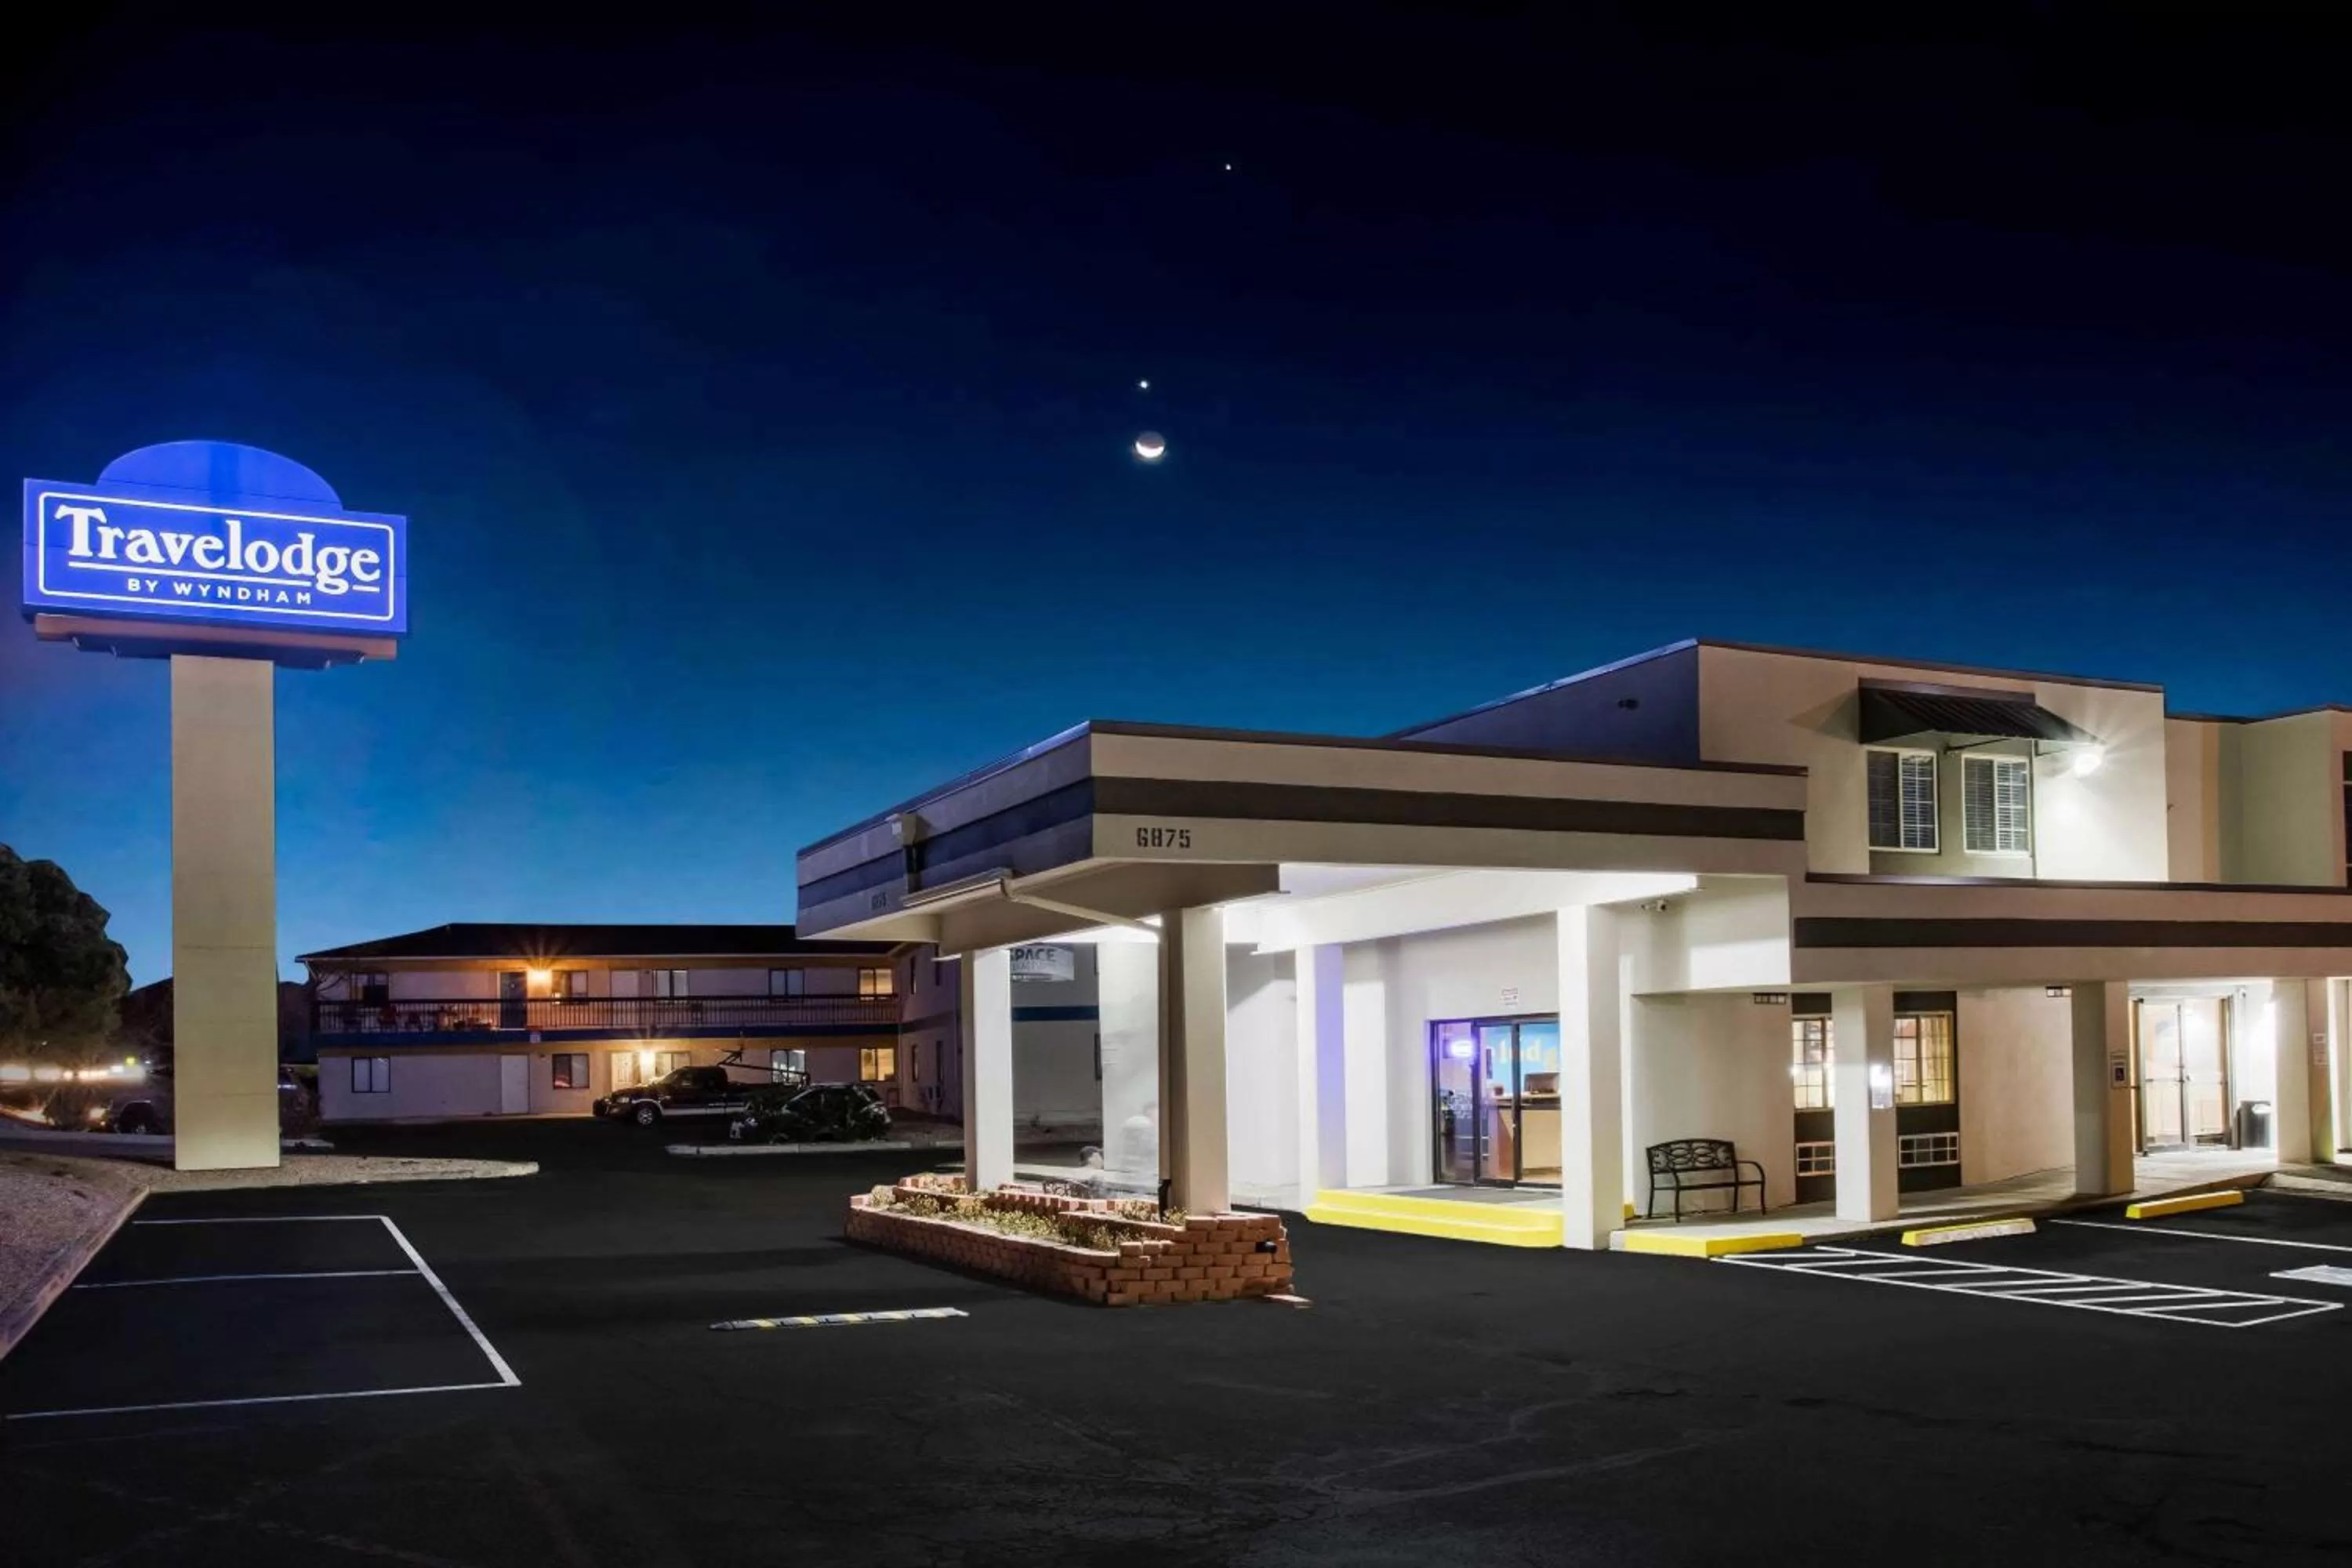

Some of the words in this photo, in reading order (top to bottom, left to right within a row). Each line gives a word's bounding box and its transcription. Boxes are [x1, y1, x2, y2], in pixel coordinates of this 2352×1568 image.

[54, 504, 381, 595] Travelodge
[127, 577, 158, 593] BY
[173, 583, 311, 604] WYNDHAM
[1137, 827, 1191, 848] 6875
